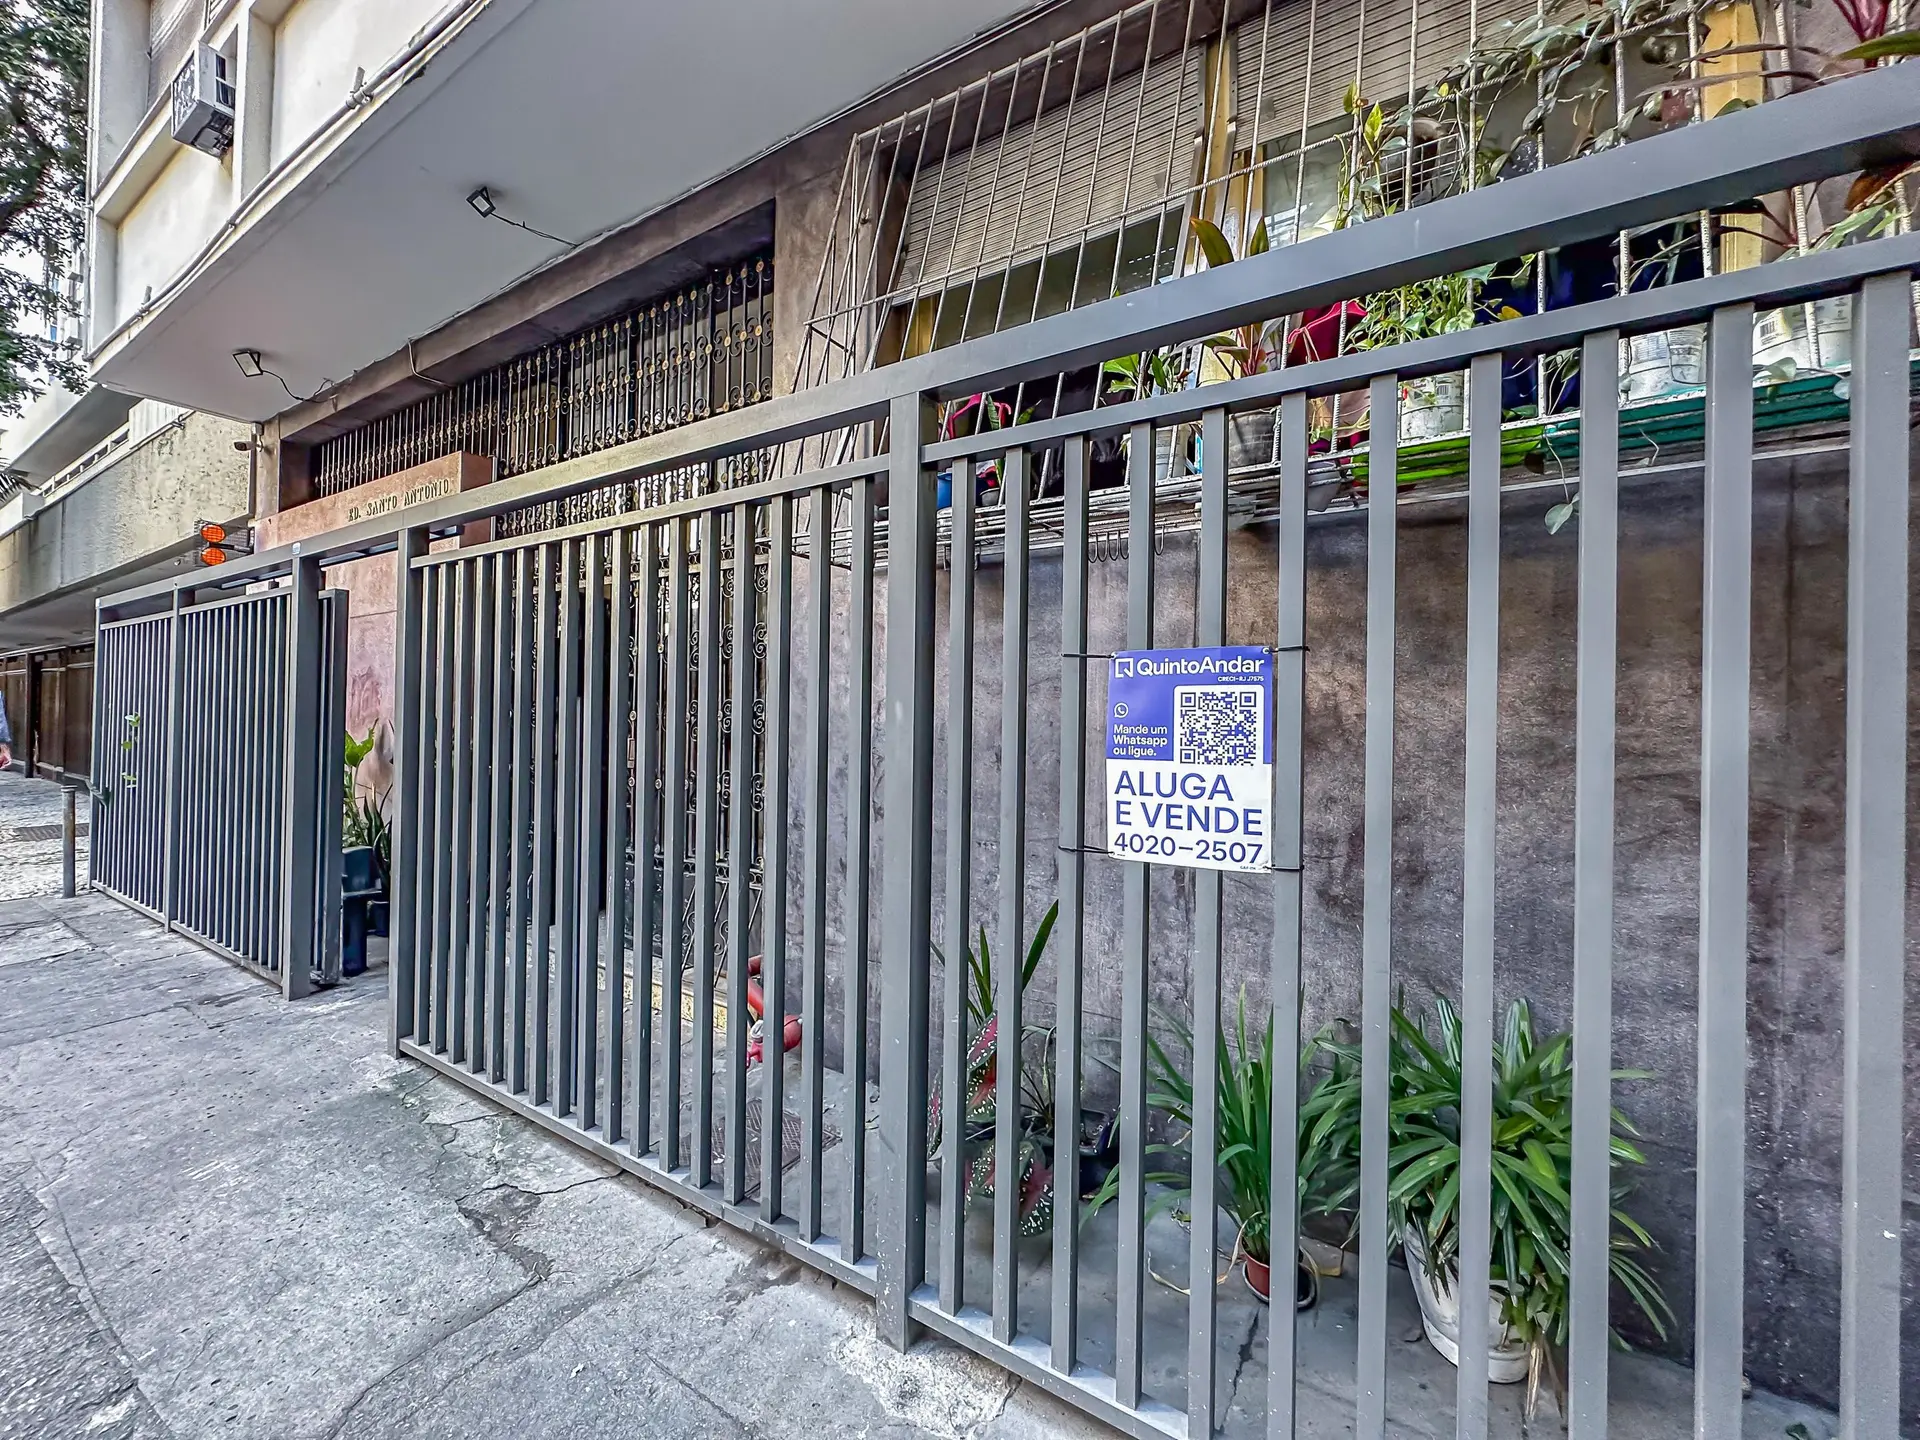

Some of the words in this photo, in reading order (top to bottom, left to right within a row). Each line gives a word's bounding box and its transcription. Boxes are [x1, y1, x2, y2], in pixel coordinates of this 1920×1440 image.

[348, 507, 361, 521] ED.
[366, 496, 398, 516] SANTO
[404, 479, 449, 506] ANTONIO
[1136, 655, 1265, 677] QuintoAndar
[1113, 724, 1148, 734] Mande
[1150, 726, 1168, 735] um
[1113, 734, 1168, 748] Whatsapp
[1113, 747, 1126, 755] ou
[1128, 745, 1157, 758] ligue.
[1114, 770, 1234, 801] ALUGA
[1116, 800, 1132, 826] E
[1140, 802, 1262, 836] VENDE
[1114, 832, 1263, 864] 4020-2507
